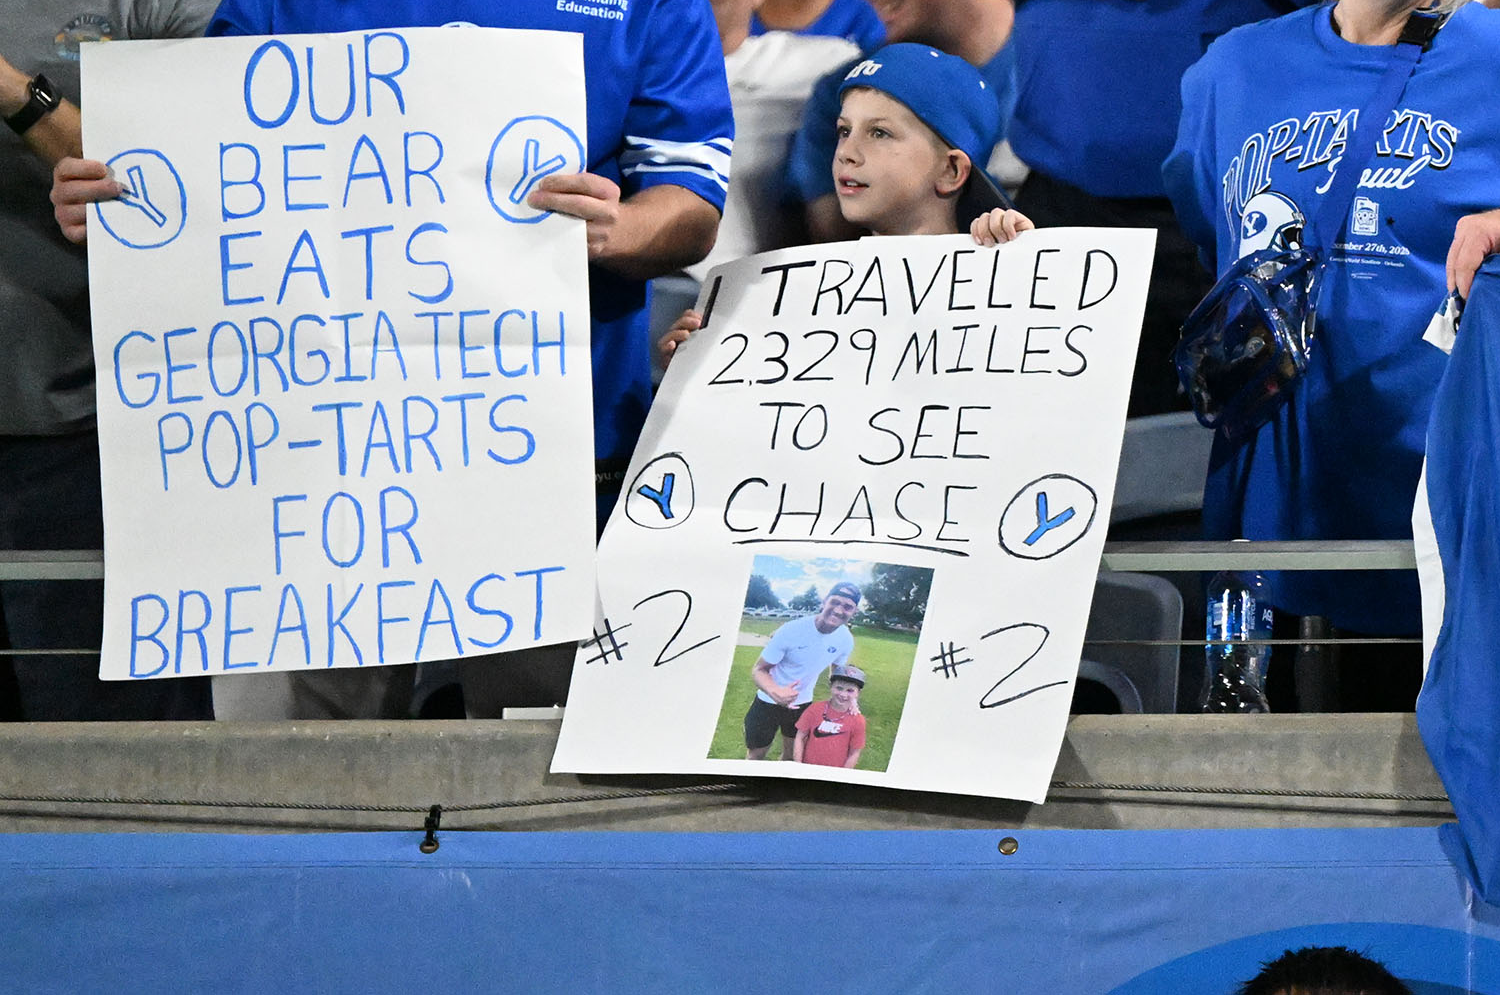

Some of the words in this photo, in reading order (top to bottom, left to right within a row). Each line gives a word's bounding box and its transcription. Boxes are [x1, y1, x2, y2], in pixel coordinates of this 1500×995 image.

[556, 0, 625, 21] Education
[242, 32, 410, 131] OUR
[218, 131, 447, 223] BEAR
[1222, 108, 1462, 241] POP-TARTS
[219, 220, 456, 307] EATS
[699, 274, 725, 331] I
[761, 248, 1120, 318] TRAVELED
[113, 311, 409, 410] GEORGIA
[416, 307, 567, 381] TECH
[890, 322, 1094, 384] MILES
[156, 393, 537, 493] POP-TARTS
[758, 401, 829, 451] TO
[857, 405, 992, 467] SEE
[272, 485, 424, 576] FOR
[723, 476, 979, 545] CHASE
[128, 565, 567, 680] BREAKFAST
[581, 589, 723, 669] #2
[930, 621, 1069, 710] #2
